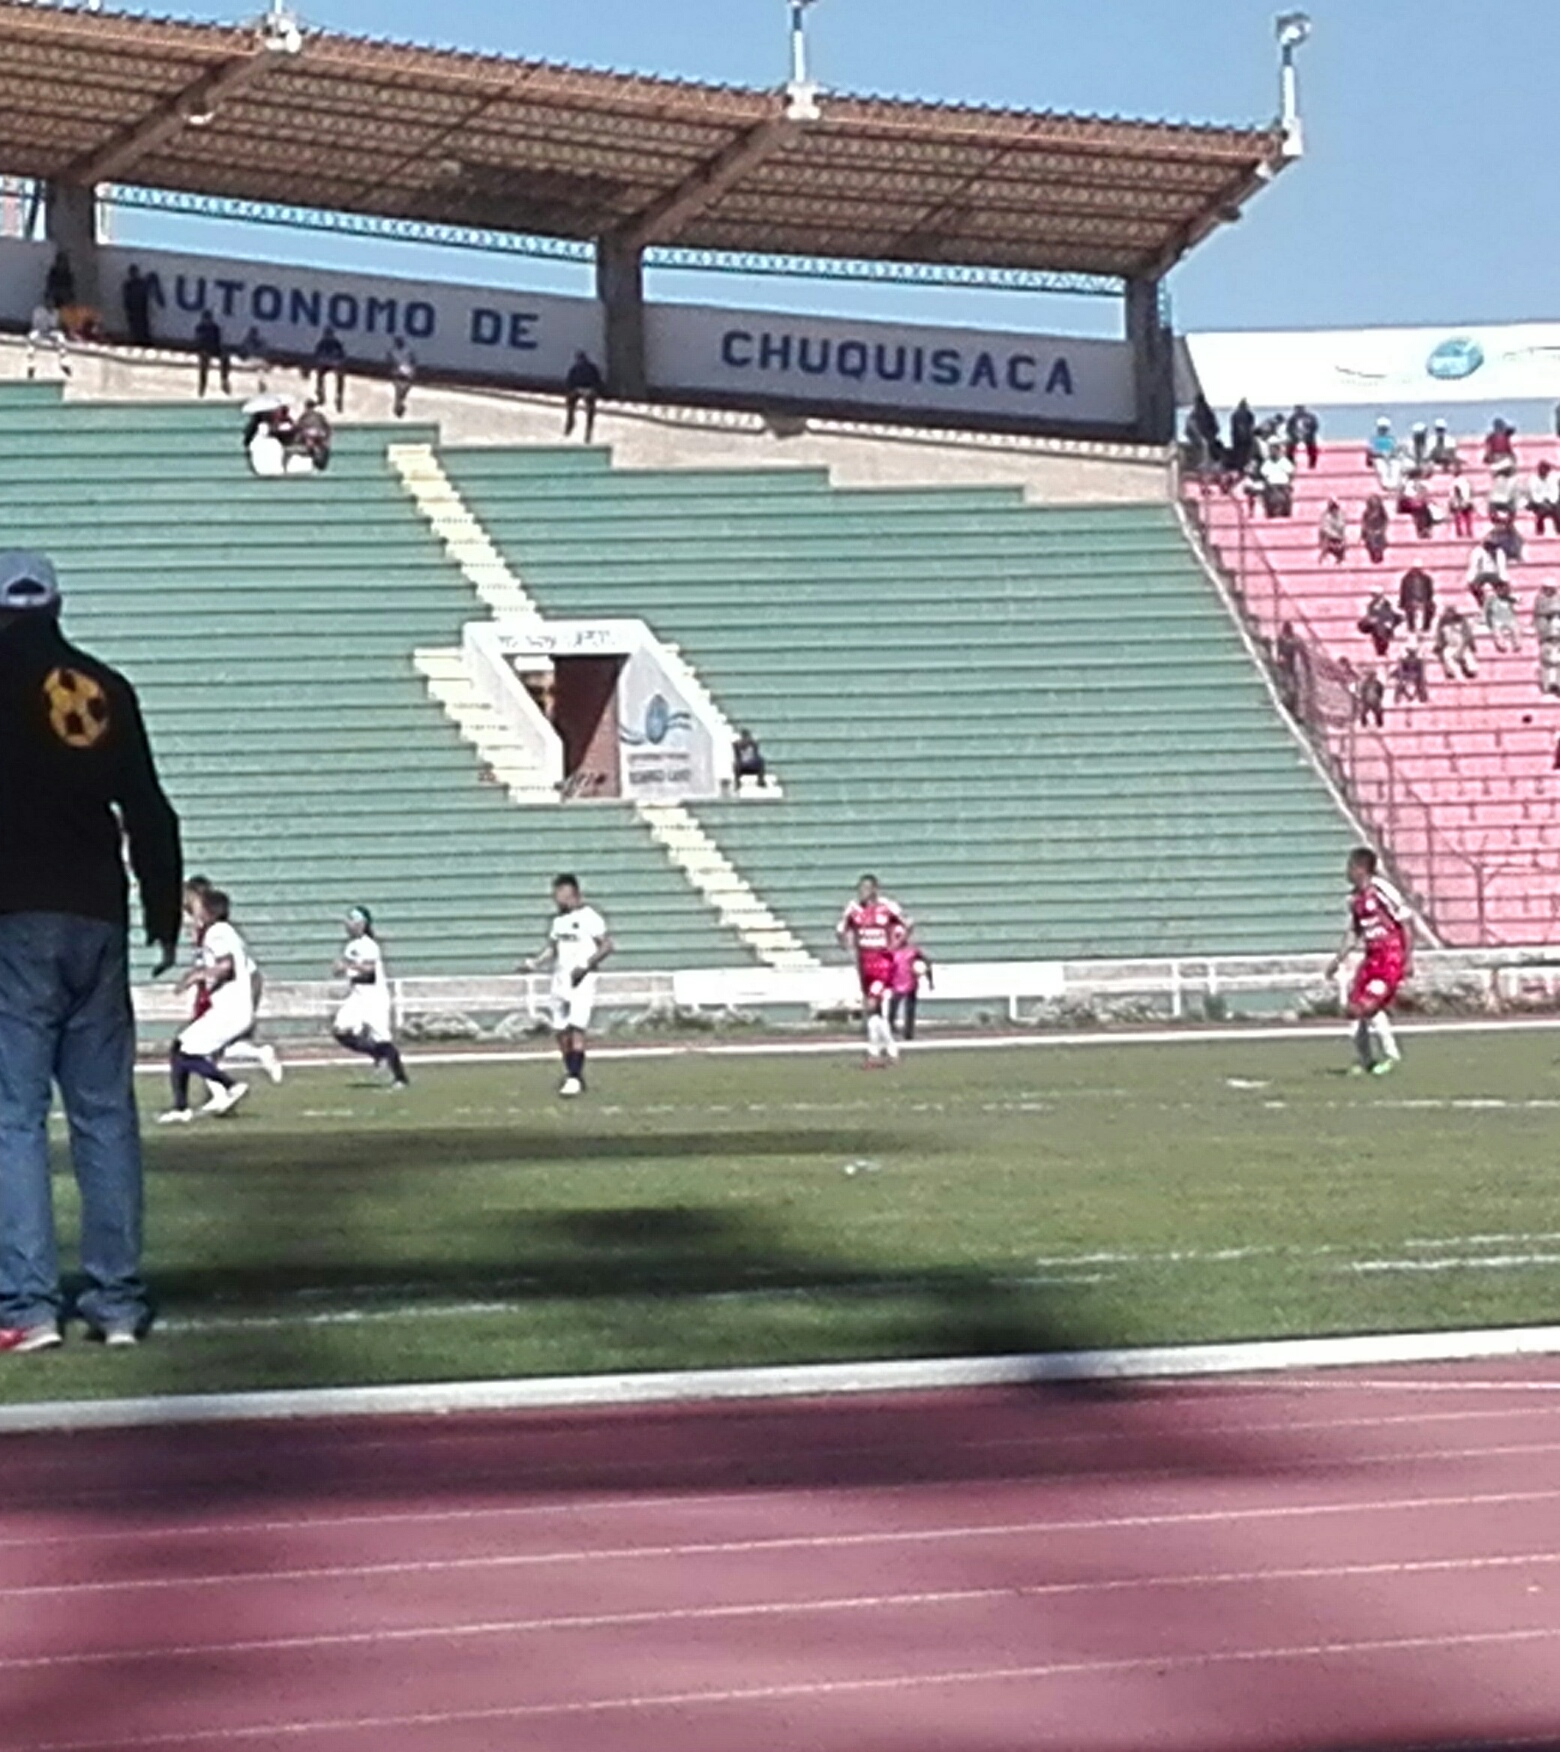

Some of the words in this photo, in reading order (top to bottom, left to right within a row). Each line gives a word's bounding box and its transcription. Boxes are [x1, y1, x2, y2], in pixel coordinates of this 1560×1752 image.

[142, 271, 435, 339] AUTONOMO
[471, 308, 539, 349] DE
[721, 331, 1074, 395] CHUQUISACA
